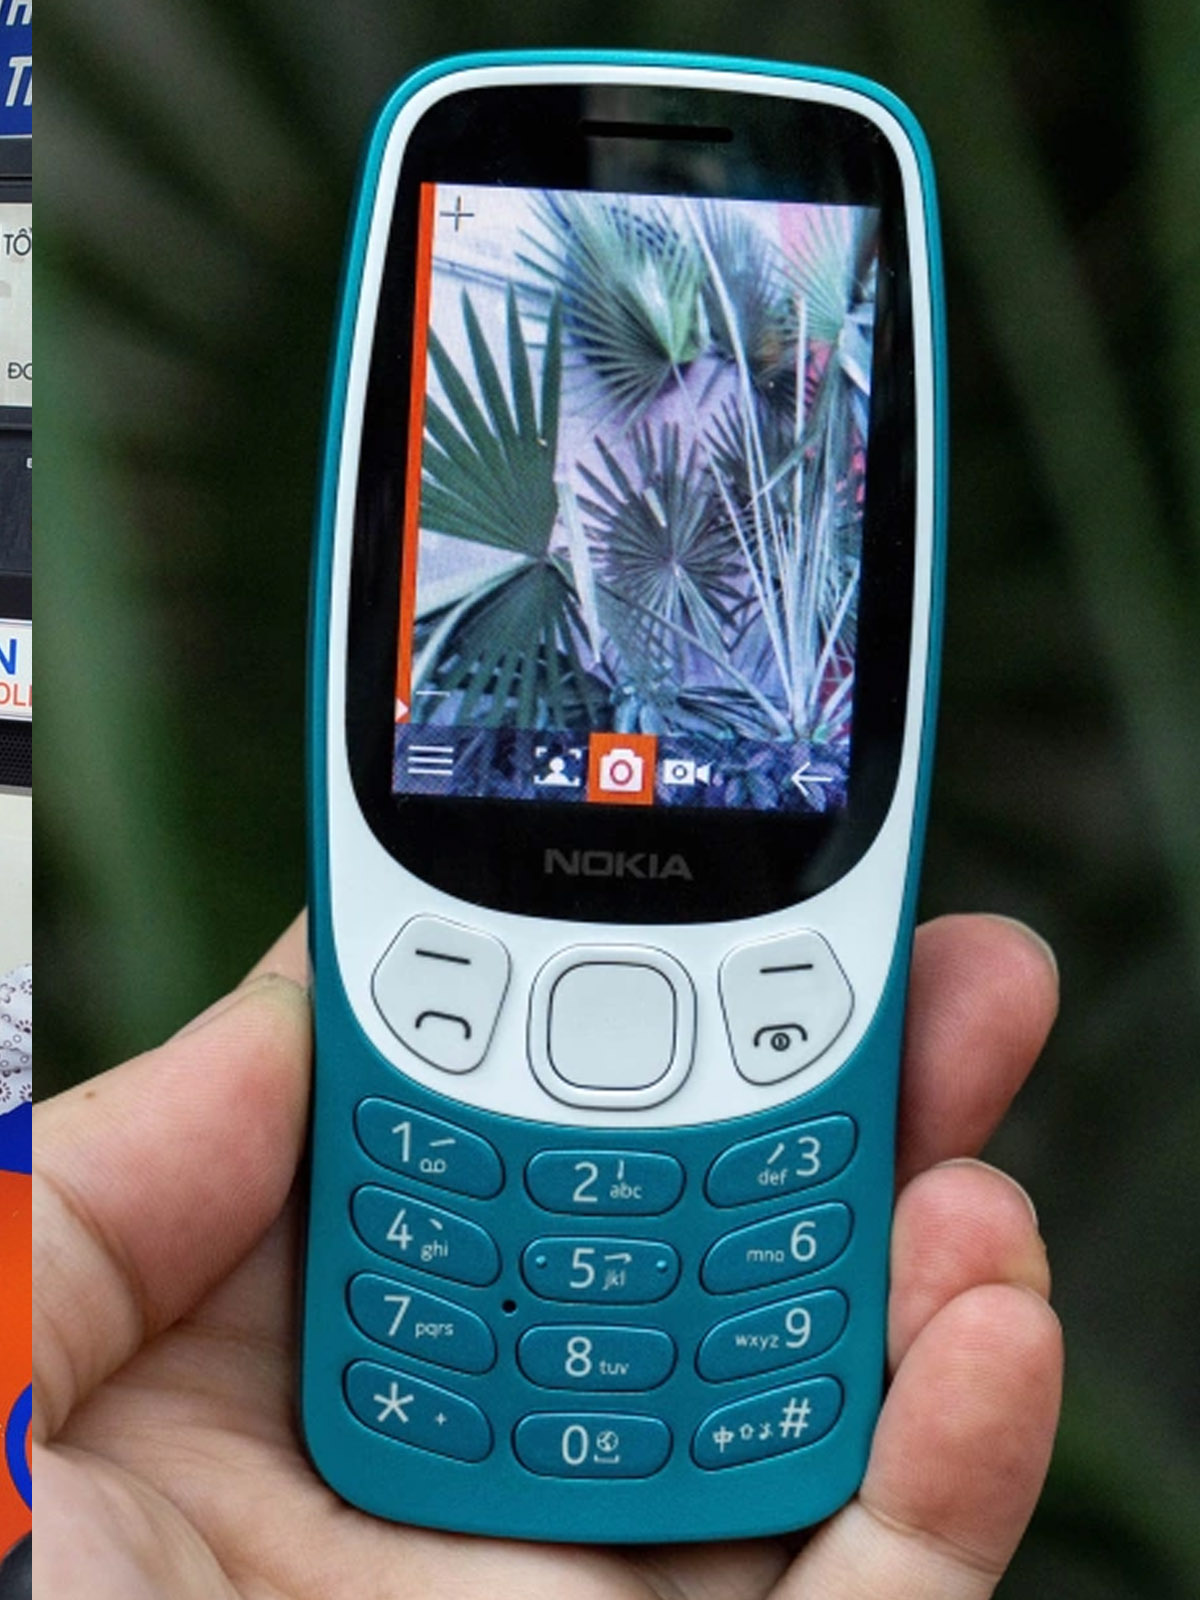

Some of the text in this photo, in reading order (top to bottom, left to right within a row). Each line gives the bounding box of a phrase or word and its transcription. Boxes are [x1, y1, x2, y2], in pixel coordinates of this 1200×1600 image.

[544, 849, 693, 880] NOKIA
[391, 1121, 411, 1162] 1
[757, 1136, 822, 1187] def 3
[572, 1161, 643, 1202] 2 abc
[386, 1209, 449, 1263] 4 ghi
[747, 1221, 818, 1263] mno 6
[569, 1248, 626, 1291] 5 jkl
[383, 1295, 454, 1339] 7 pqrs
[735, 1307, 812, 1350] wxyz 9
[565, 1336, 630, 1377] 8 tuv
[561, 1424, 590, 1466] 0
